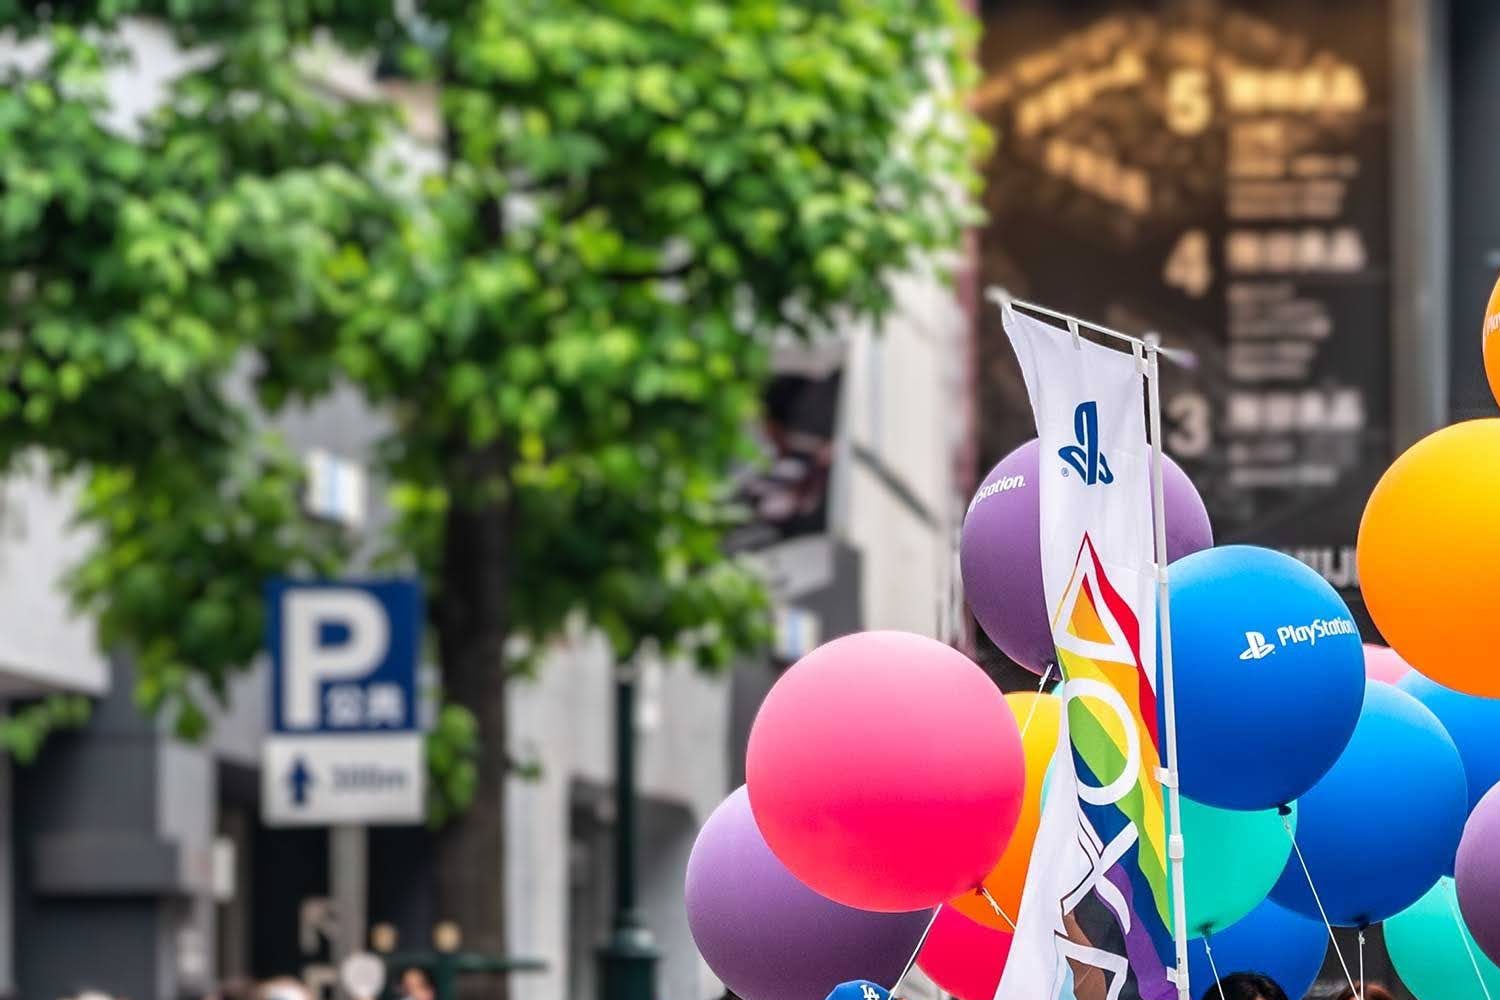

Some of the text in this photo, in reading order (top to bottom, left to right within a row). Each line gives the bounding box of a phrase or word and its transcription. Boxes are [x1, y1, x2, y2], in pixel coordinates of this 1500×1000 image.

[1165, 229, 1211, 294] 4
[1167, 393, 1209, 457] 3
[279, 585, 391, 730] P
